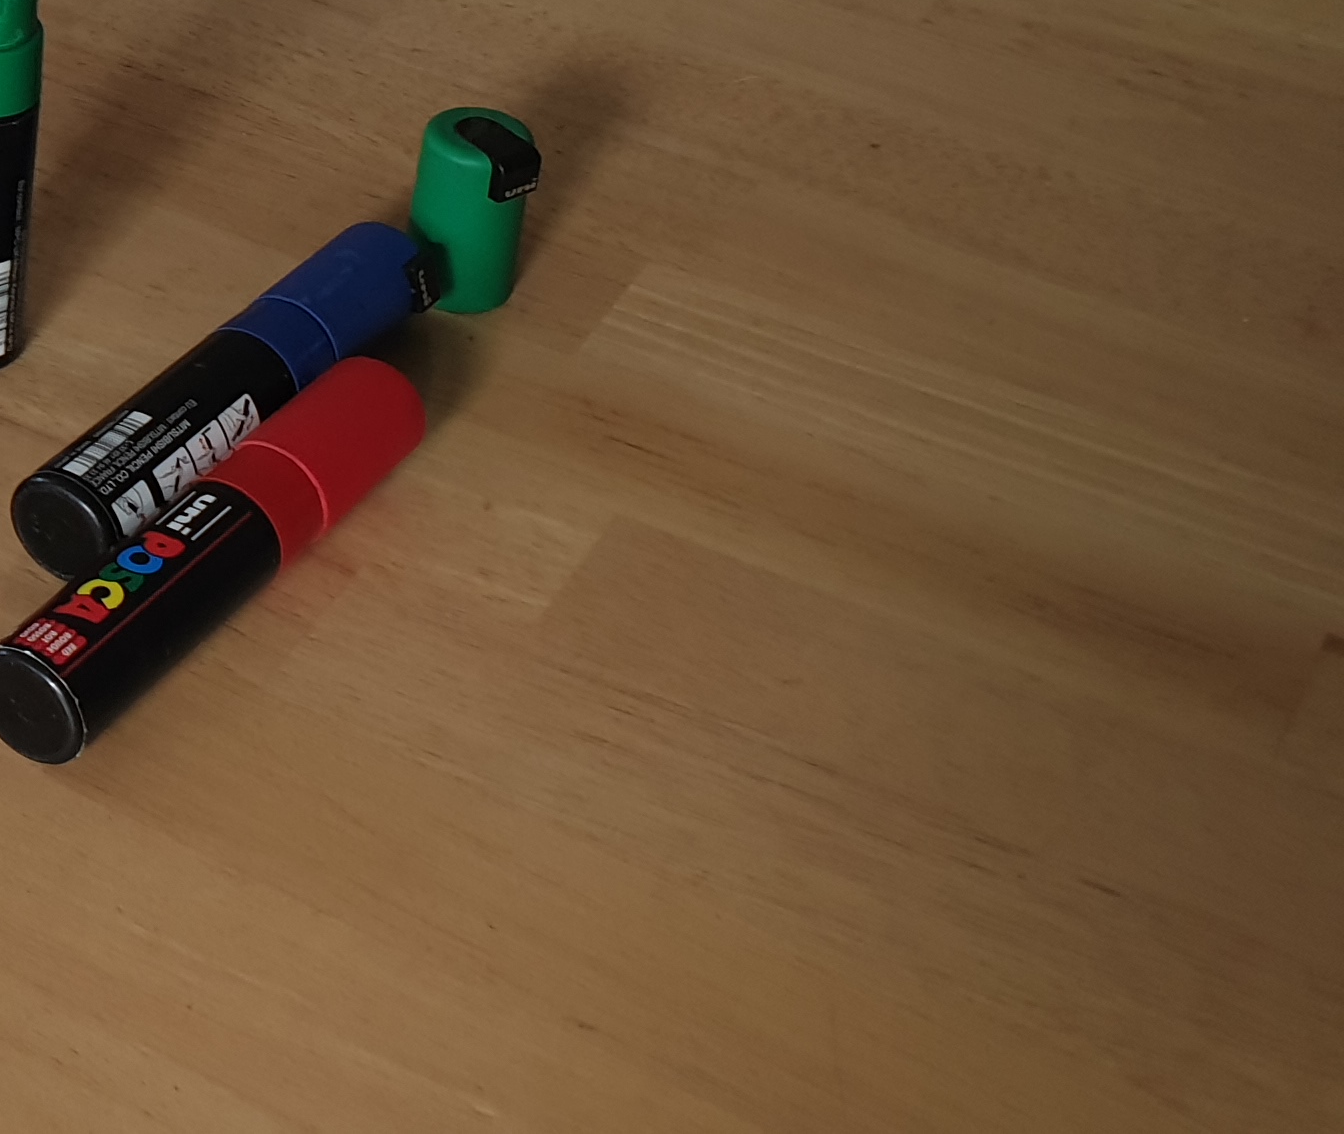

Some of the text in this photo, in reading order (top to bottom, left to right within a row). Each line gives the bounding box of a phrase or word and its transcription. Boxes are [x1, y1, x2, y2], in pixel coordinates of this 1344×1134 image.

[149, 417, 192, 455] MITSUBISHI
[125, 448, 154, 475] PENCIL
[165, 493, 217, 538] uni
[53, 531, 187, 625] POSCA
